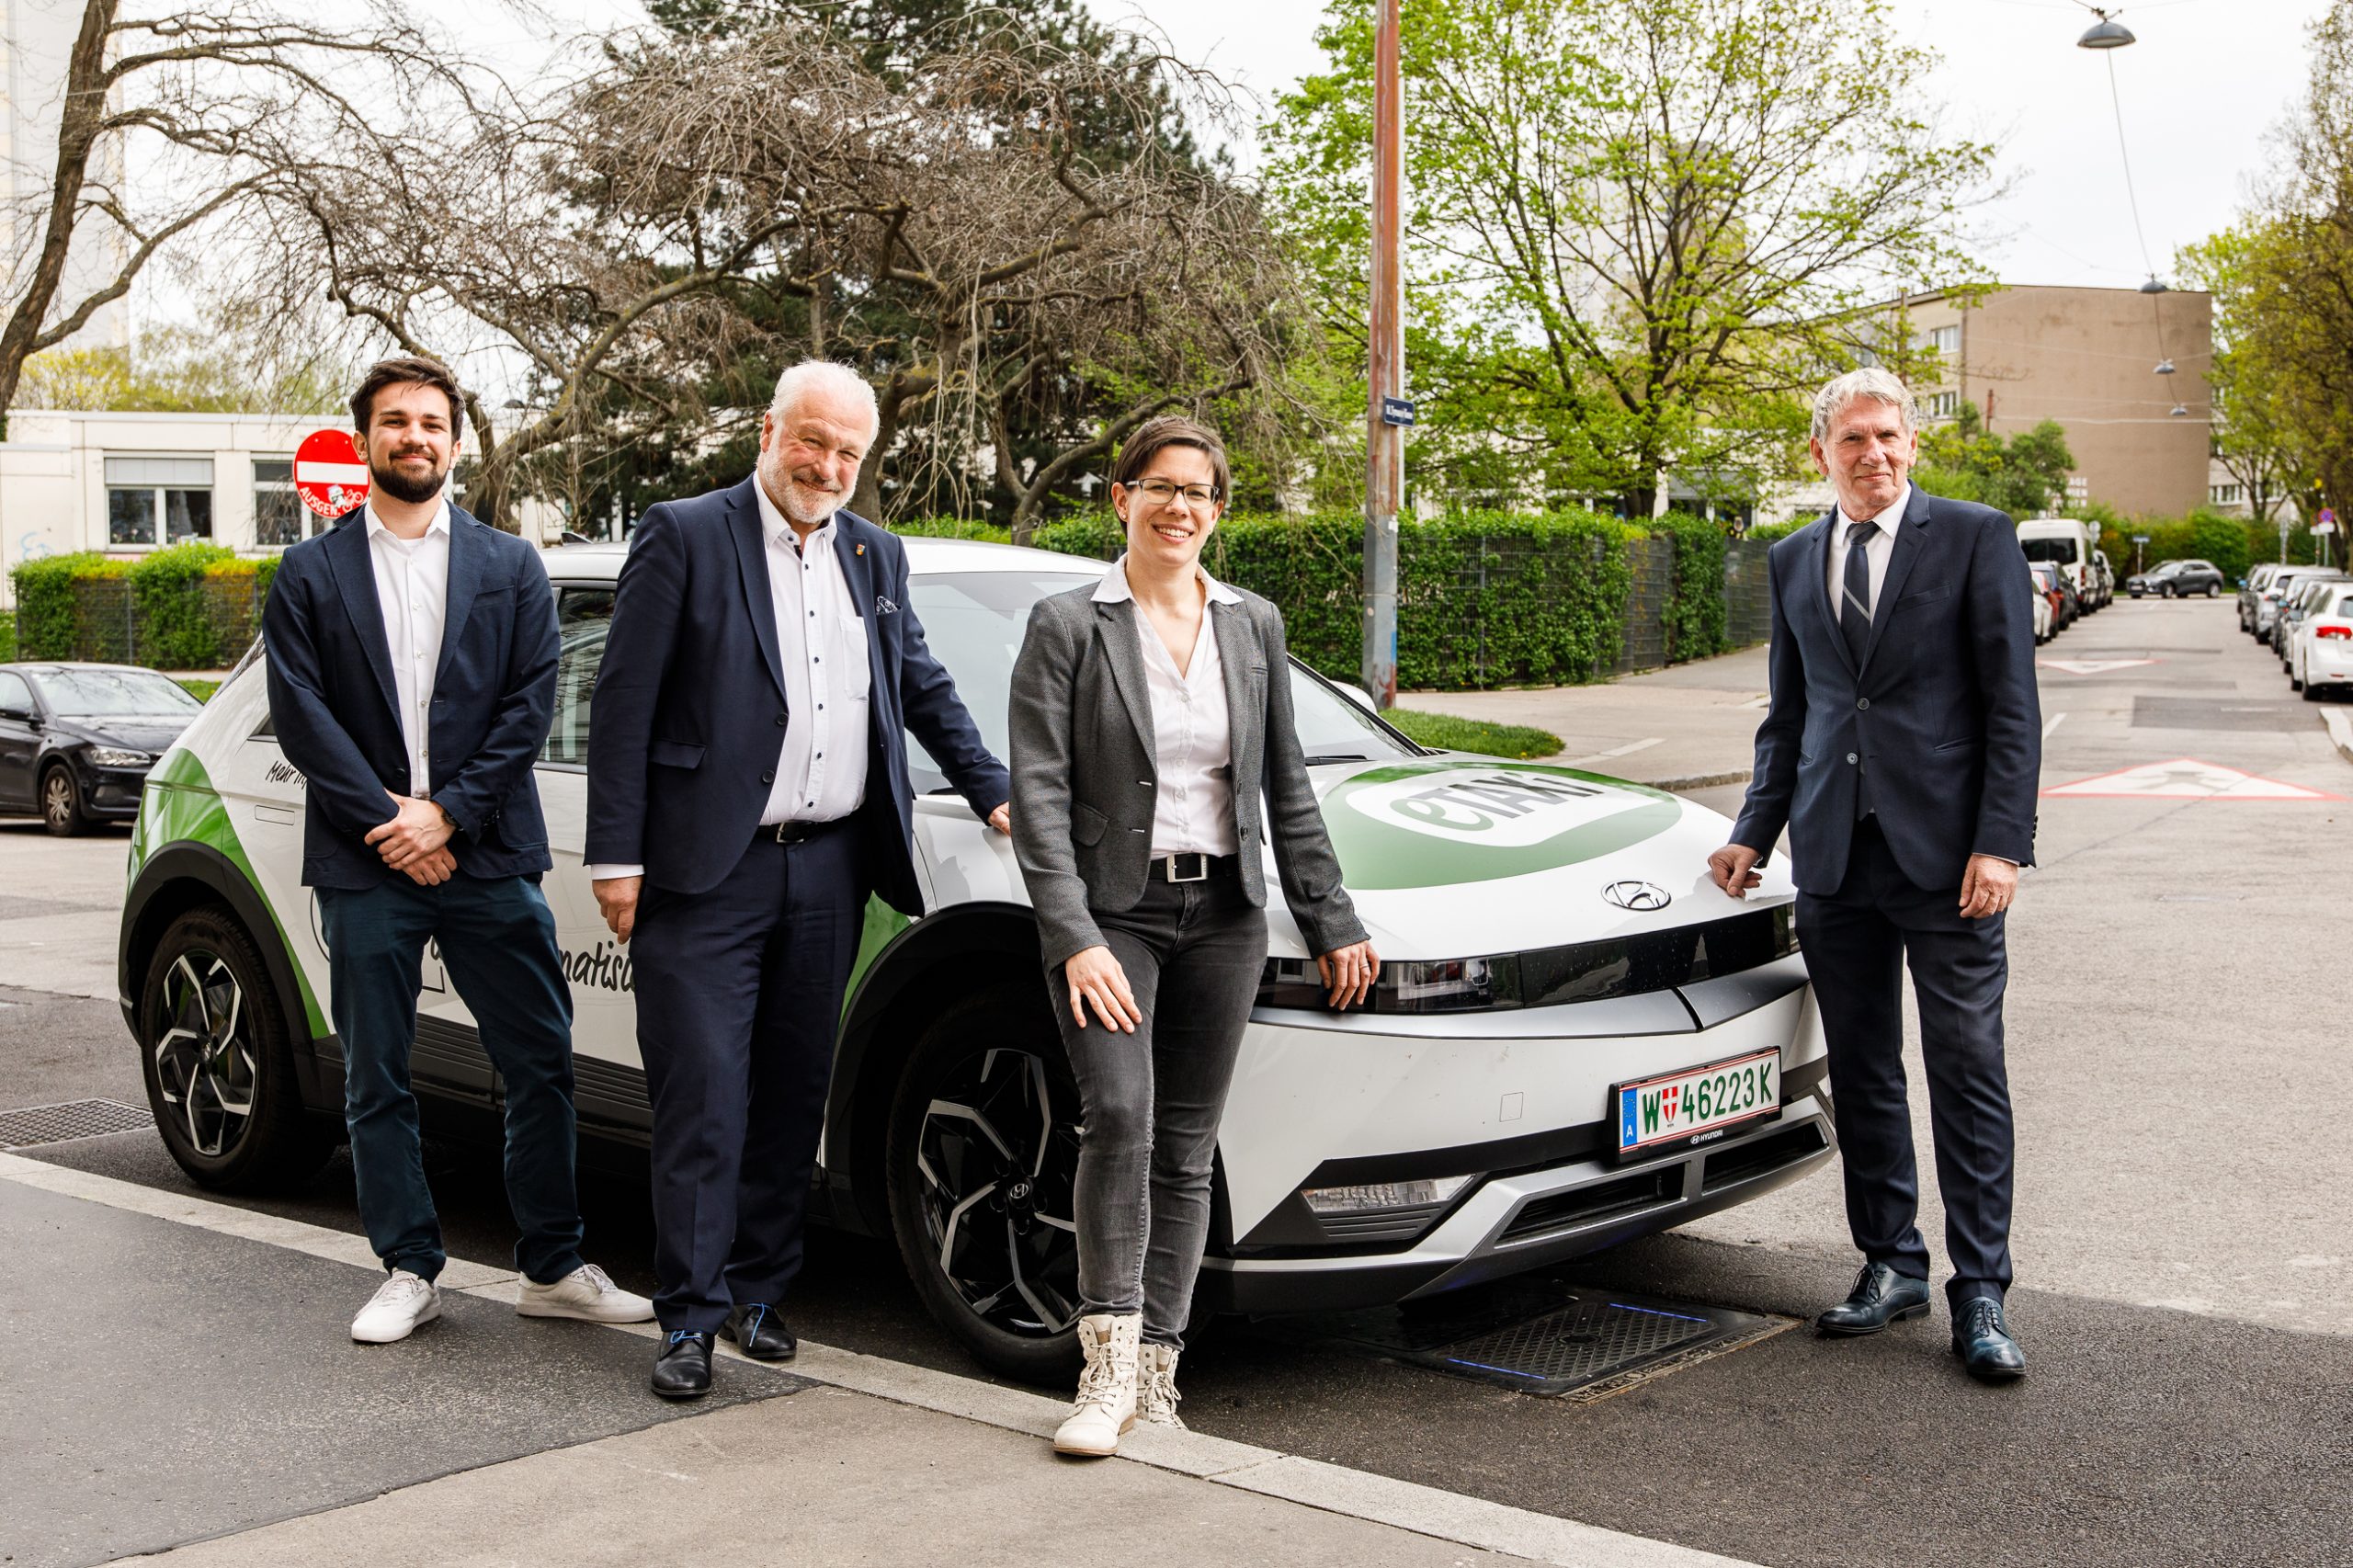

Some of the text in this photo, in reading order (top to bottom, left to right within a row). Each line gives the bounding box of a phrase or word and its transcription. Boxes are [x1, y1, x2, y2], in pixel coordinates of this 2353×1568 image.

[265, 760, 296, 783] Mehr
[1642, 1089, 1662, 1135] W
[1626, 1124, 1634, 1138] A
[1699, 1129, 1724, 1142] HYUNDAI
